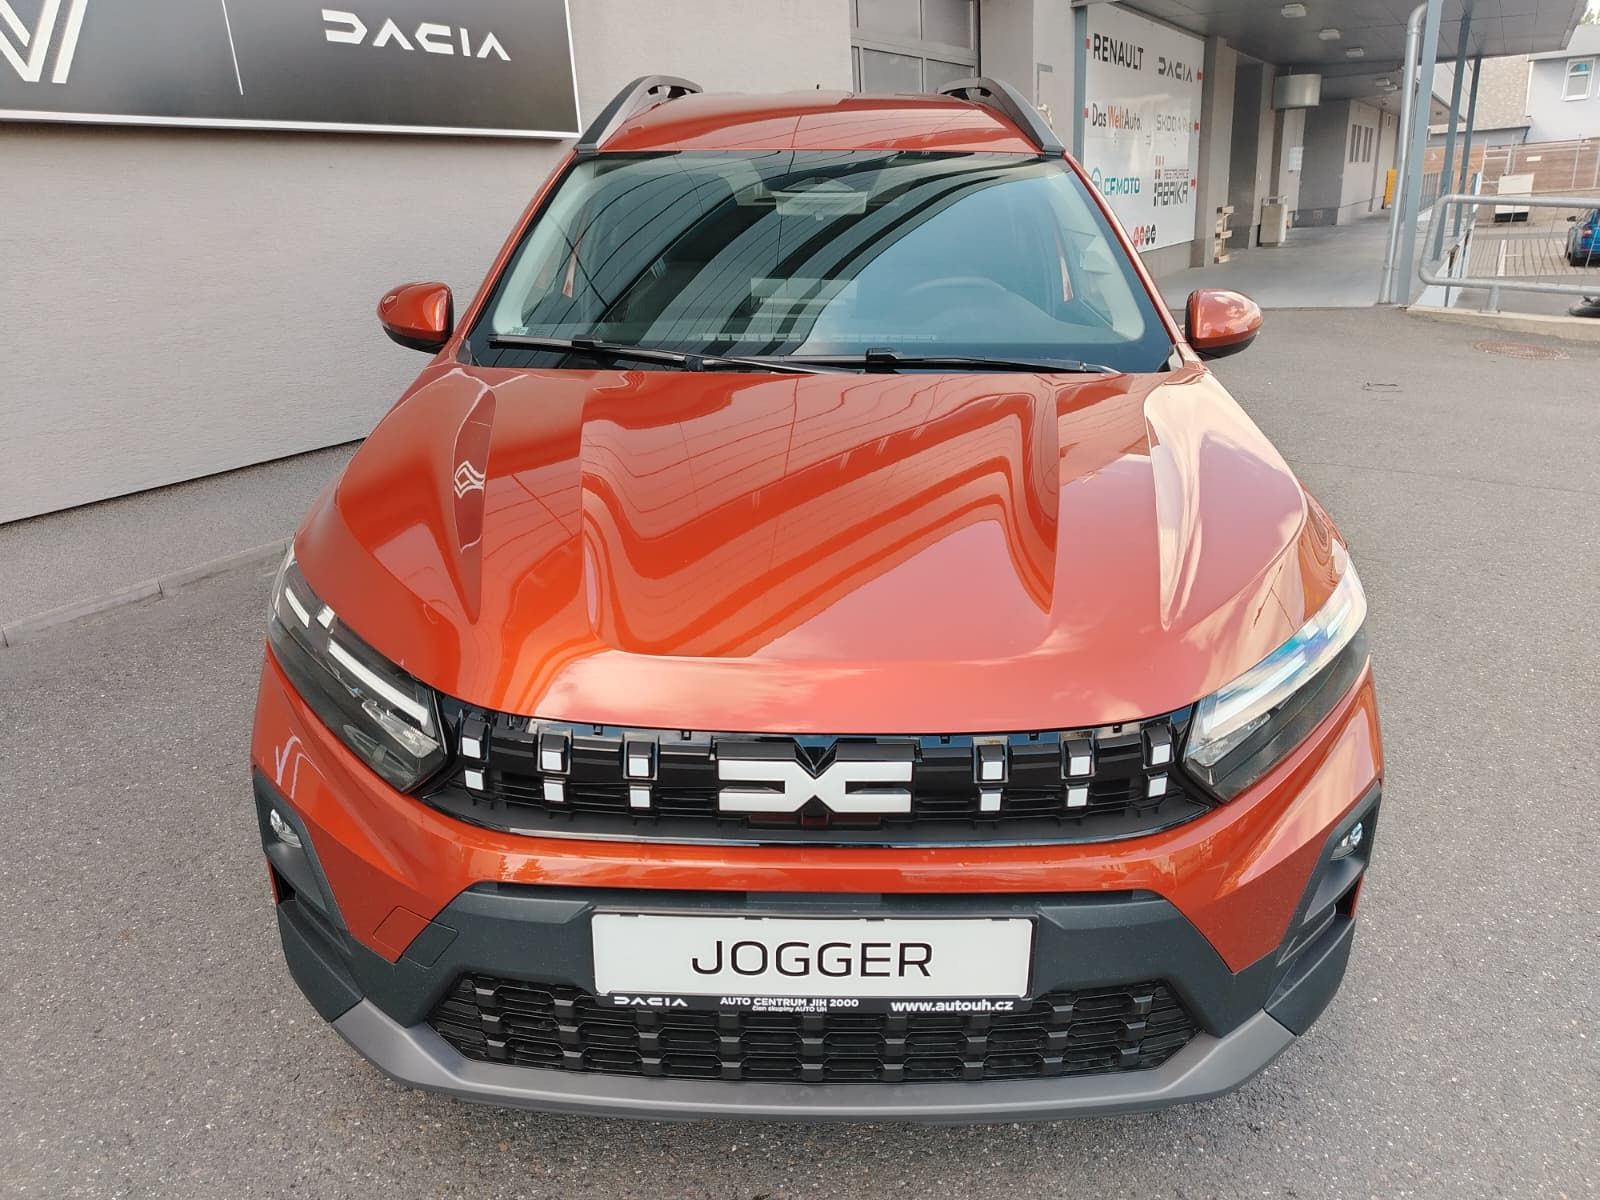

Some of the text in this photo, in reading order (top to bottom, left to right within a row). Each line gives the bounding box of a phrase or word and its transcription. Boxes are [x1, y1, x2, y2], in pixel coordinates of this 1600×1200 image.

[322, 9, 511, 61] DACIA
[1093, 33, 1144, 71] RENAULT
[1158, 56, 1193, 82] DACIA
[1092, 103, 1107, 127] Das
[1103, 177, 1141, 196] CFMOTO
[691, 940, 933, 977] JOGGER
[613, 996, 688, 1007] DACIA
[719, 997, 859, 1008] AUTO CENTRUM JIH 2000
[890, 999, 1014, 1012] www.autouh.cz
